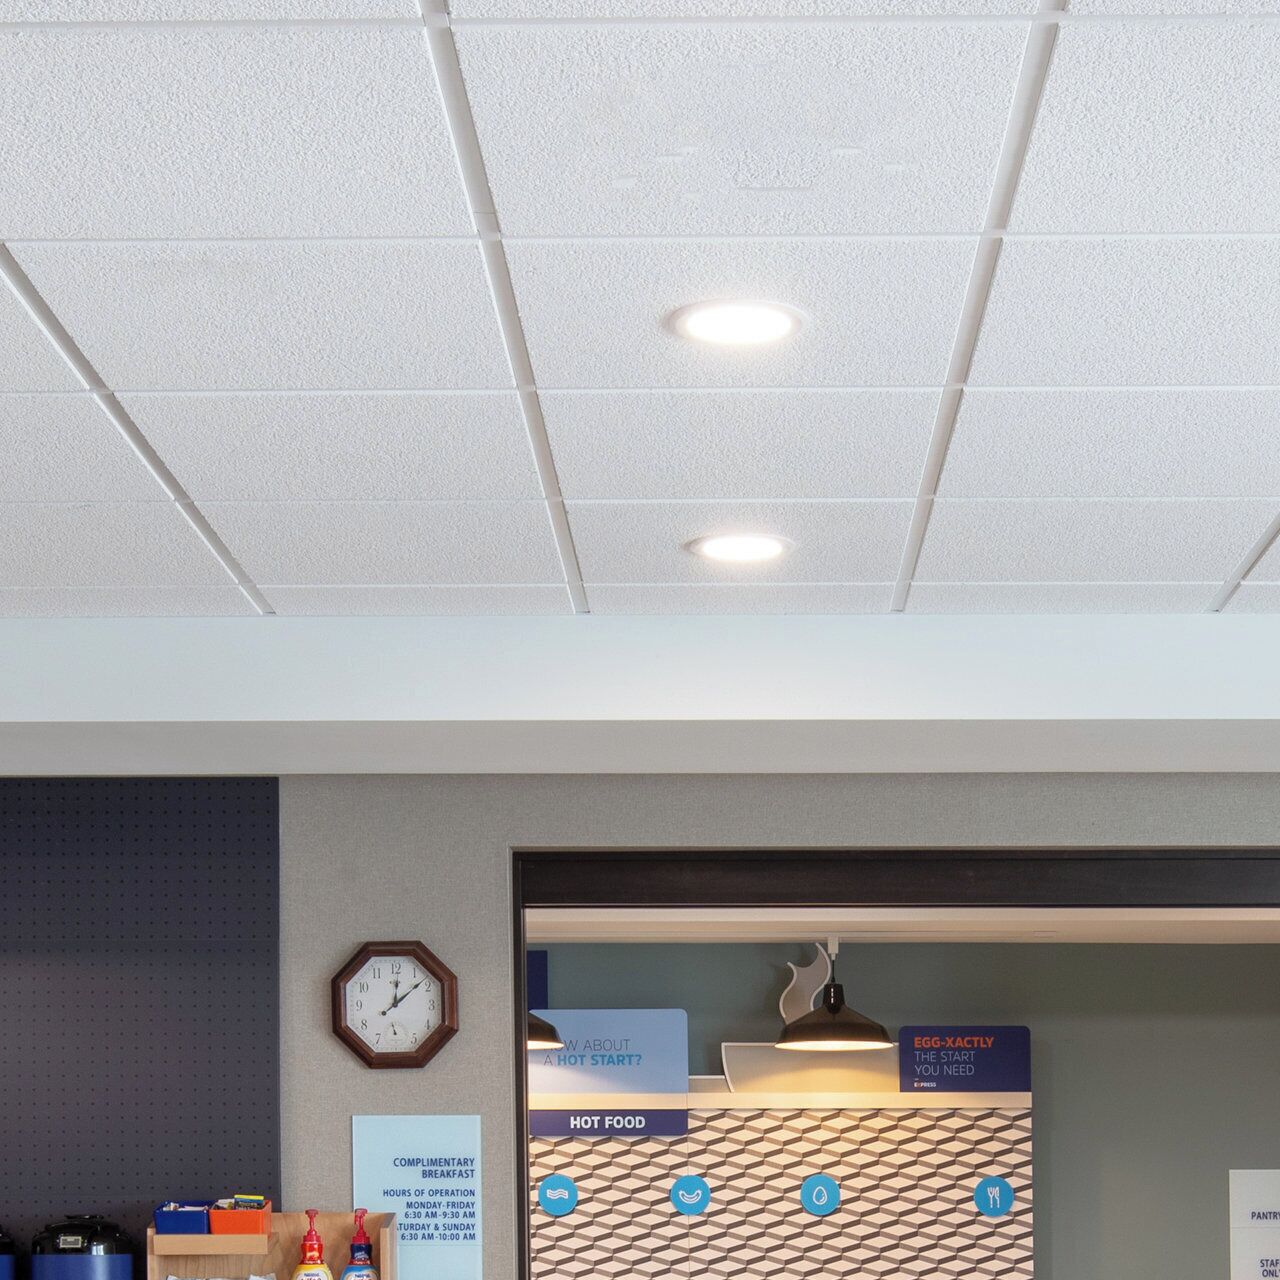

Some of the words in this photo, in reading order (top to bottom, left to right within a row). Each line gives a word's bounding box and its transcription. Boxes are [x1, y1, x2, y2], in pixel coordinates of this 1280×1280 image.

[582, 1039, 631, 1051] ABOUT
[914, 1036, 995, 1048] EGG-XACTLY
[544, 1054, 554, 1066] A
[557, 1054, 587, 1066] HOT
[591, 1054, 642, 1066] START?
[914, 1050, 937, 1062] THE
[941, 1050, 976, 1062] START
[914, 1064, 940, 1076] YOU
[943, 1064, 975, 1076] NEED
[570, 1116, 601, 1129] HOT
[604, 1116, 646, 1129] FOOD
[393, 1157, 475, 1167] COMPLIMENTARY
[422, 1169, 476, 1179] BREAKFAST
[383, 1189, 412, 1197] HOURS
[414, 1189, 425, 1197] OF
[428, 1189, 476, 1197] OPERATION
[404, 1211, 422, 1219] 6:30
[462, 1211, 476, 1219] AM
[396, 1223, 431, 1231] TURDAY
[434, 1223, 440, 1231] &
[442, 1223, 476, 1231] SUNDAY
[400, 1233, 419, 1241] 6:30
[463, 1233, 476, 1241] AM
